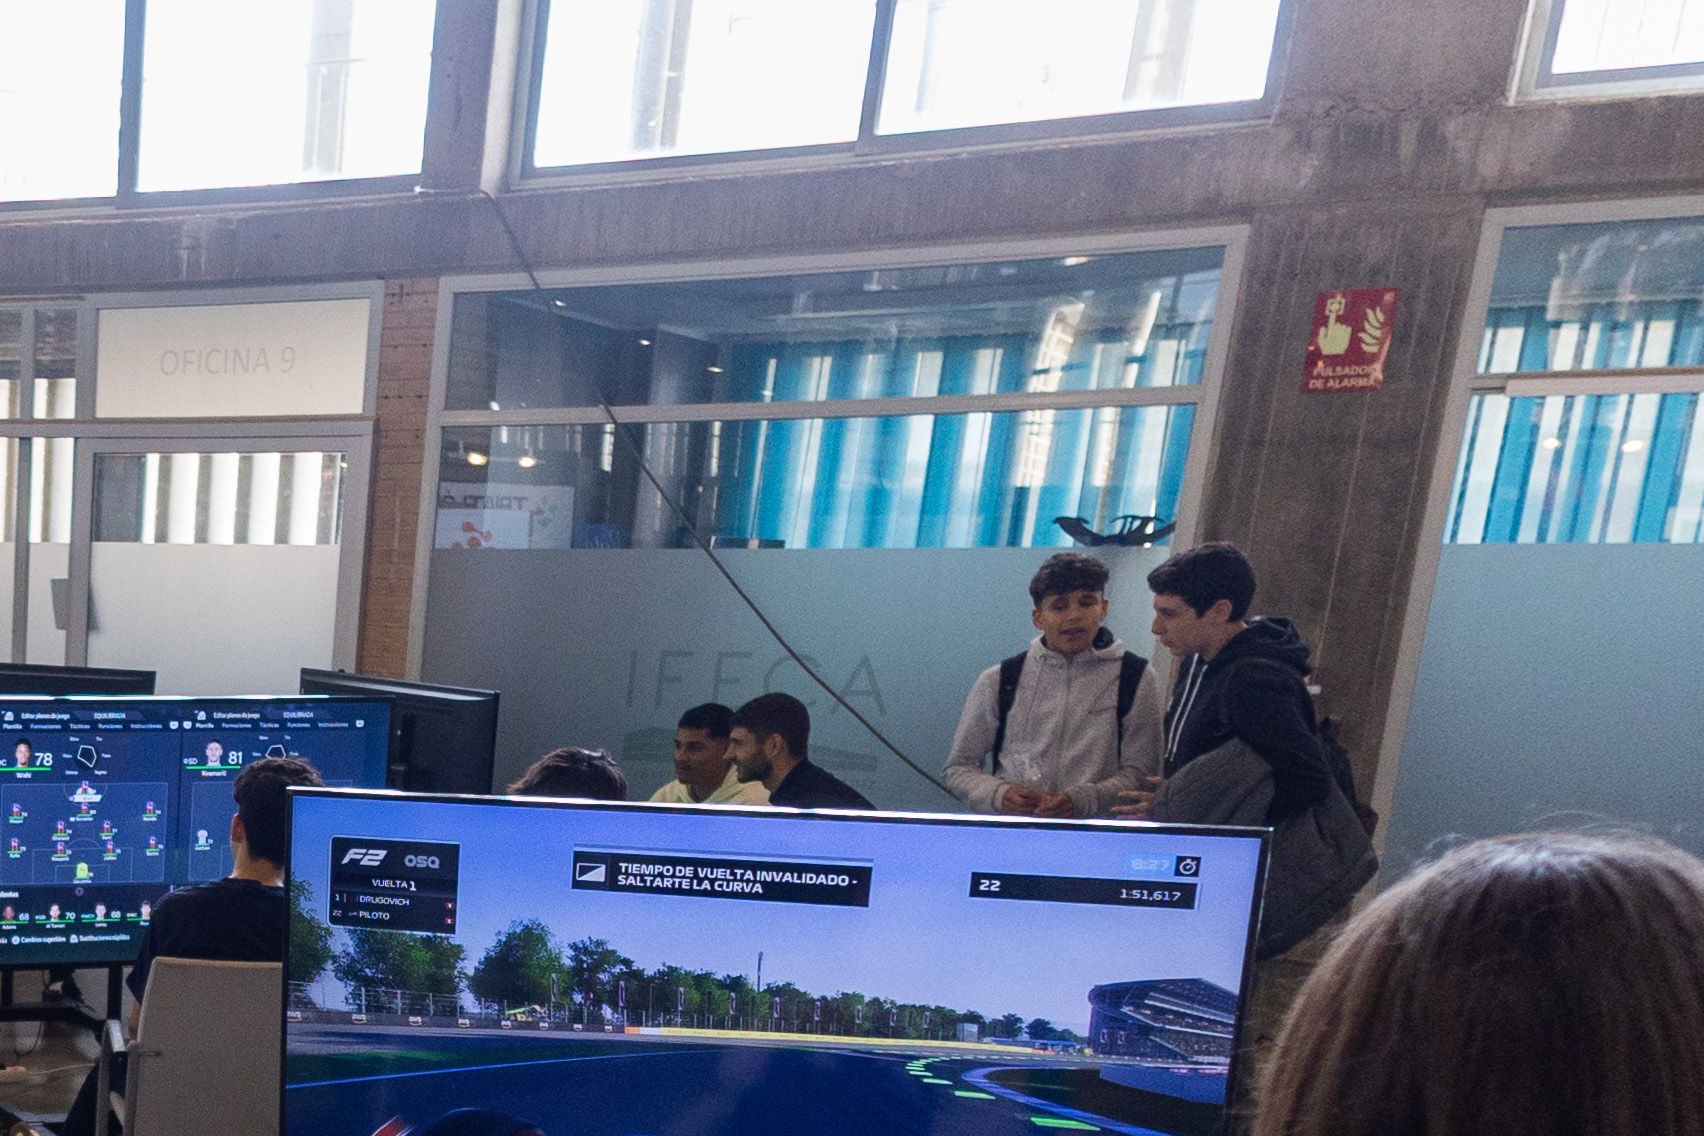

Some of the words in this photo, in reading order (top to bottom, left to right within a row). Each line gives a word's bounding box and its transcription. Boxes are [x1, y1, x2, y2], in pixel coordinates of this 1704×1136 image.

[160, 348, 271, 376] OFICINA
[281, 346, 296, 373] 9
[1308, 378, 1326, 389] DE
[1326, 376, 1376, 388] ALARMA
[34, 752, 53, 766] 78
[228, 751, 243, 765] 81
[341, 848, 388, 867] F2
[403, 854, 440, 869] OSQ
[618, 862, 674, 876] TIEMPO
[675, 866, 694, 877] DE
[697, 867, 756, 881] VUELTA
[756, 870, 850, 887] INVALIDADO
[371, 879, 408, 889] VUELTA
[409, 881, 417, 891] 1
[617, 874, 691, 890] SALTARTE
[692, 878, 711, 891] LA
[714, 880, 763, 894] CURVA
[978, 879, 1001, 892] 22
[359, 895, 410, 906] DRUGOVICH
[65, 912, 76, 920] 70
[359, 911, 390, 921] PILOTO
